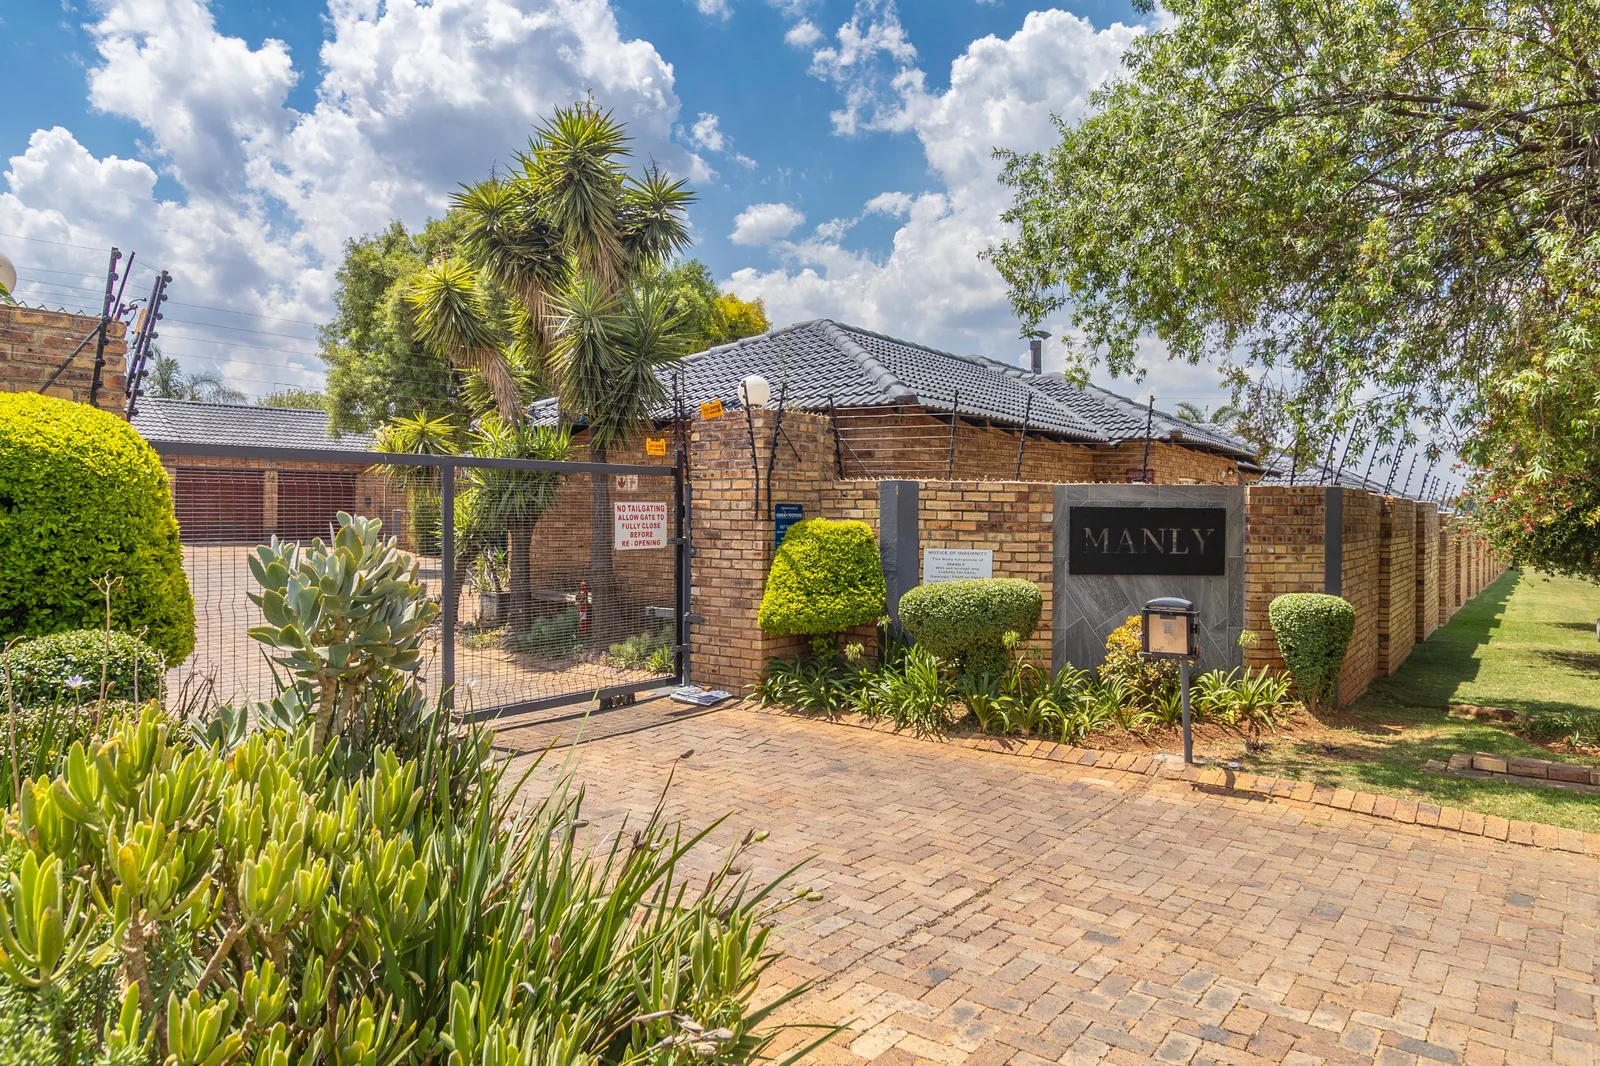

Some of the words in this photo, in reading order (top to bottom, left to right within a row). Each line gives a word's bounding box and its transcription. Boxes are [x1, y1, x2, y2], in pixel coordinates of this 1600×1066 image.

[616, 504, 626, 512] NO
[628, 504, 665, 512] TAILGATING
[1082, 527, 1214, 555] MANLY
